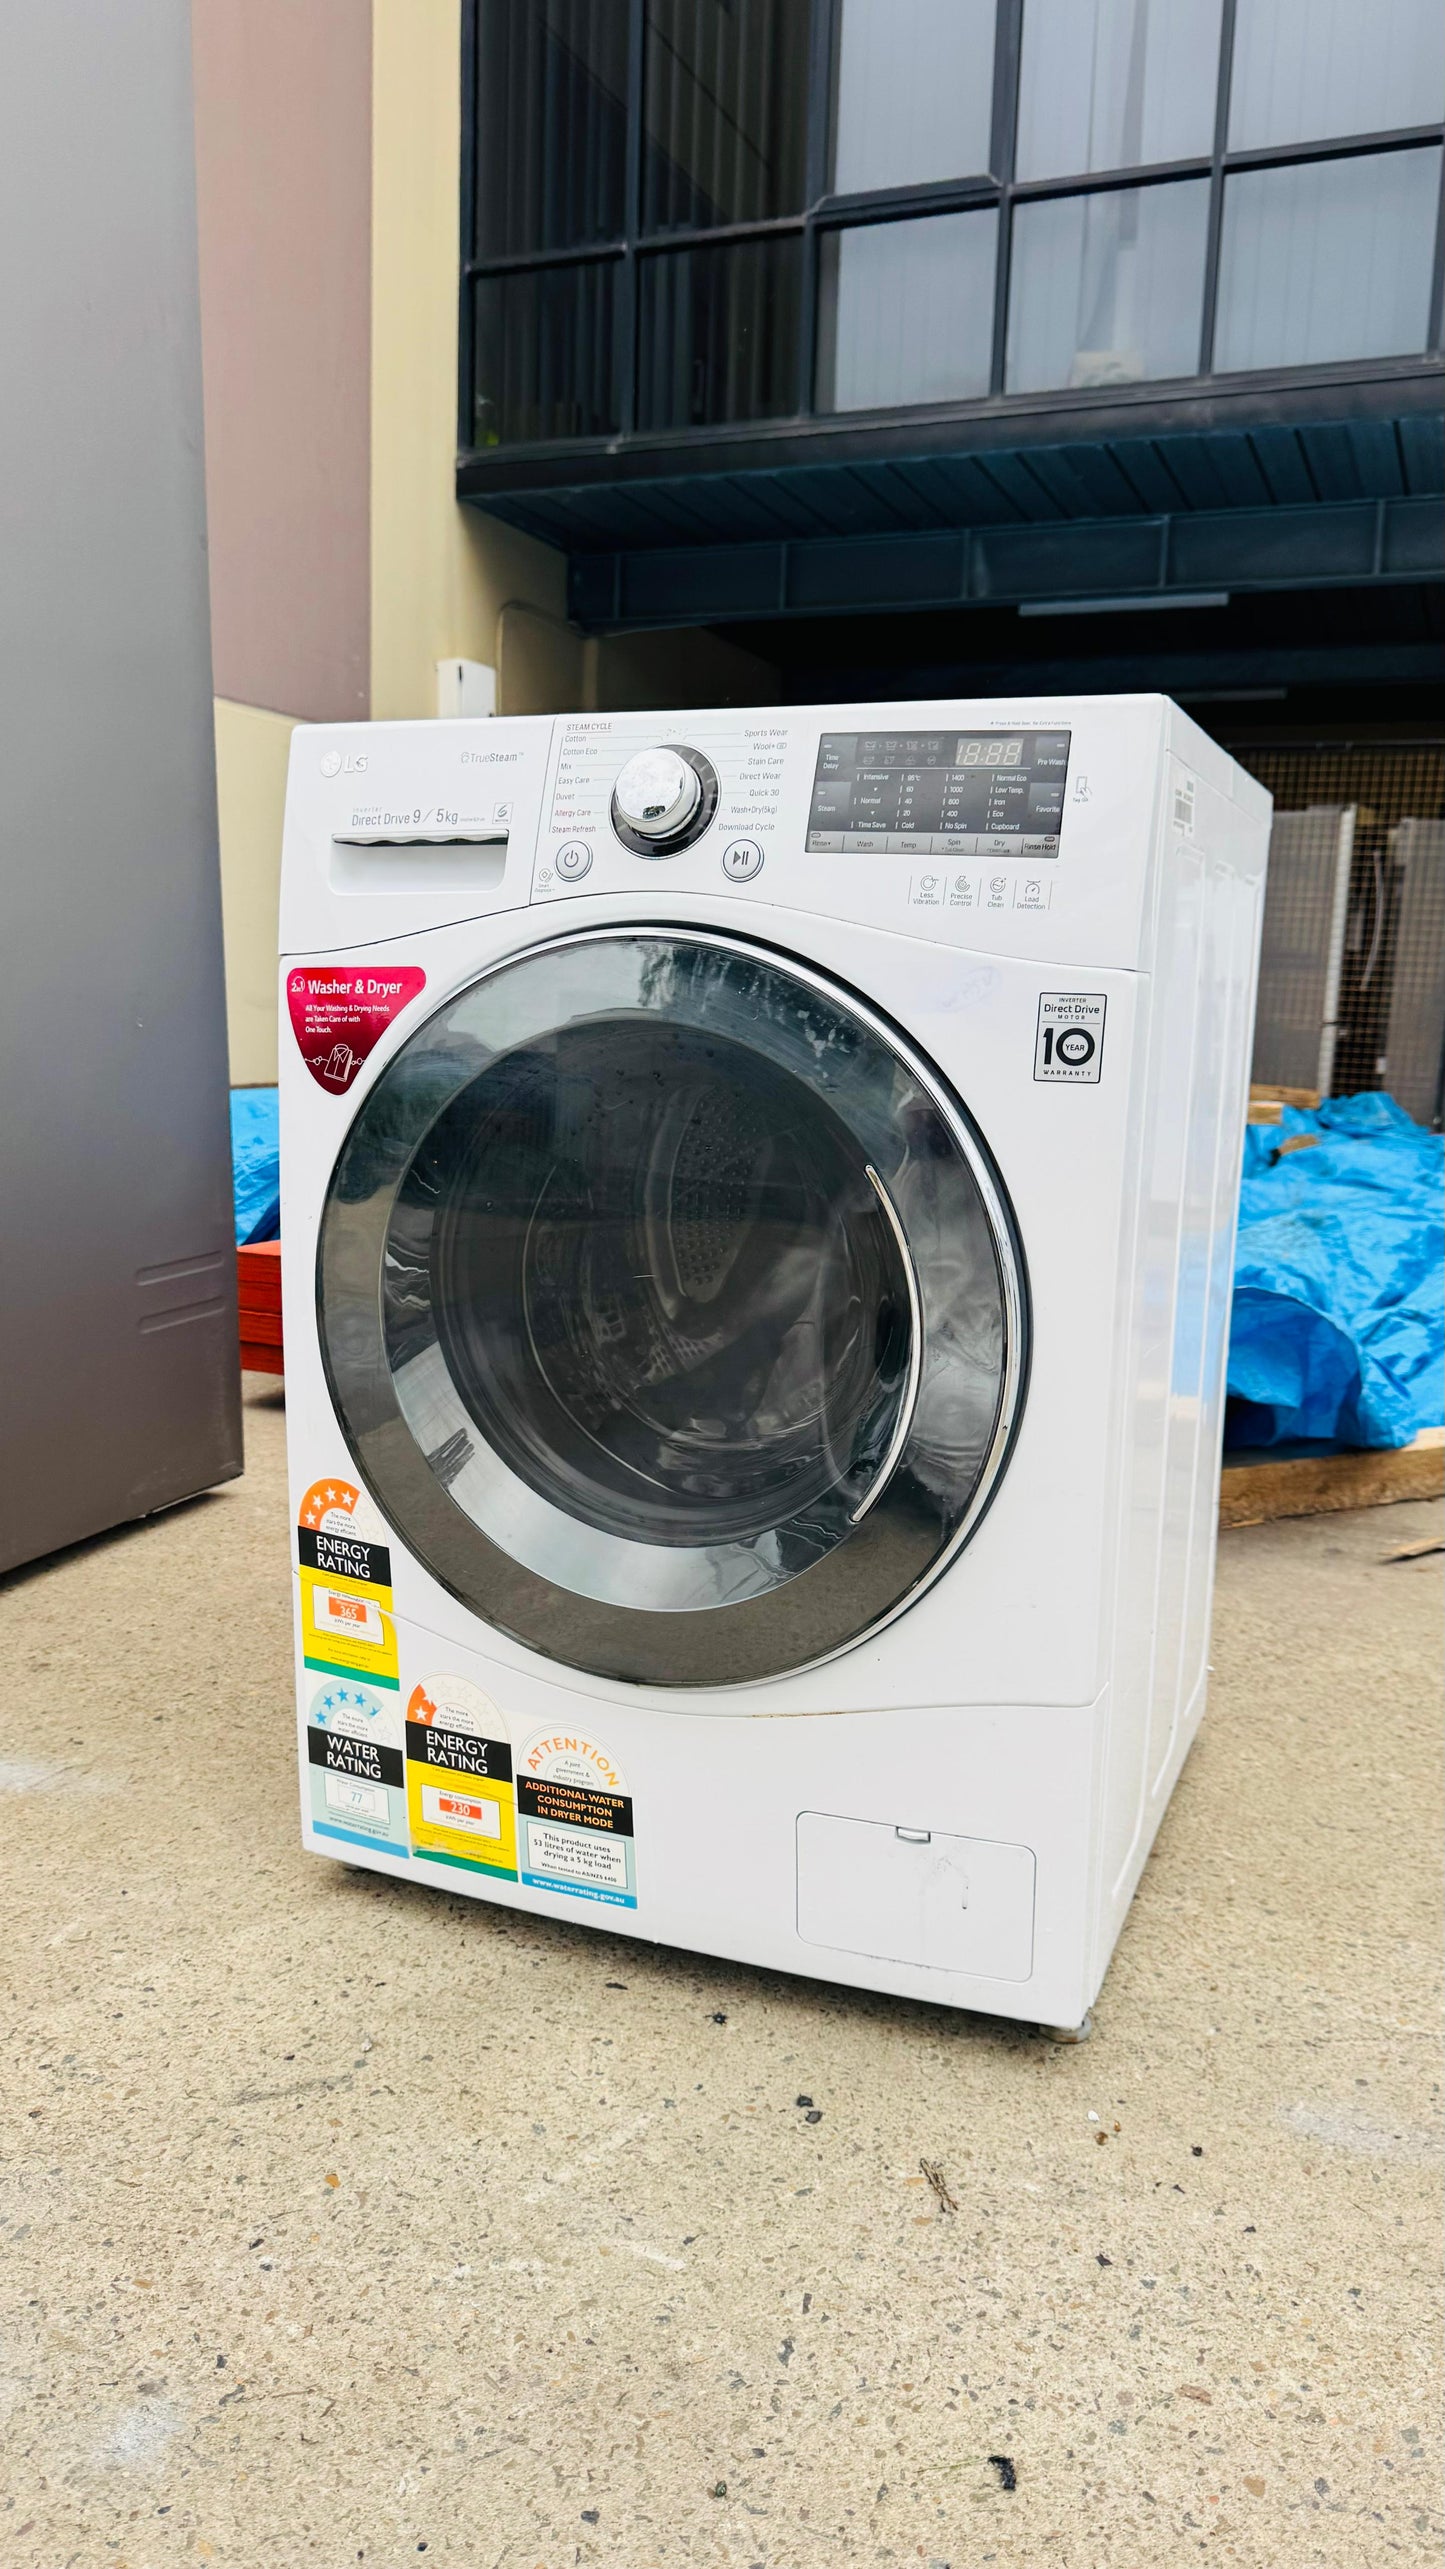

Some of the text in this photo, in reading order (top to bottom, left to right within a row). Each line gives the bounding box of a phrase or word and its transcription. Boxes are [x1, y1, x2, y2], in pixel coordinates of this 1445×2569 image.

[566, 722, 612, 732] STEAM CYCLE
[744, 729, 789, 739] Sports Wear
[565, 735, 587, 743] Cotton
[562, 747, 598, 756] Cotton Eco
[344, 753, 368, 773] LG
[747, 757, 785, 766] Stain Care
[1037, 758, 1066, 766] Pre Wash
[560, 762, 572, 771] Mix
[823, 762, 839, 771] Delay
[558, 776, 590, 786] Easy Care
[739, 772, 782, 781] Direct Wear
[863, 773, 889, 781] Intensive
[951, 774, 965, 782] 1400
[996, 774, 1028, 782] Normal Eco
[749, 788, 780, 797] Quick 30
[995, 786, 1024, 795] Low Temp.
[555, 792, 576, 801] Duvet
[860, 797, 882, 805] Normal
[993, 798, 1006, 806] Iron
[554, 809, 592, 818] Allergy Care
[903, 809, 911, 817] 20
[1035, 805, 1060, 813] Favorite
[352, 814, 381, 826] Direct
[384, 812, 410, 825] Drive
[551, 825, 597, 834] Steam Refresh
[718, 822, 776, 832] Download Cycle
[858, 821, 887, 829] Time Save
[901, 821, 915, 829] Cold
[953, 822, 968, 830] Spin
[990, 823, 1020, 831] Cupboard
[856, 840, 874, 848] Wash
[901, 841, 917, 849] Temp
[947, 838, 961, 846] Spin
[994, 839, 1006, 847] Dry
[1024, 842, 1057, 851] Rinse Hold
[919, 891, 934, 899] Less
[913, 897, 940, 906] Vibration
[307, 978, 352, 994] Washer
[354, 978, 364, 994] &
[367, 978, 403, 999] Dryer
[305, 1004, 390, 1014] All Your Washing & Drying Needs
[1044, 1003, 1100, 1014] Direct Drive
[314, 1015, 329, 1023] Taken
[328, 1015, 341, 1023] Care
[341, 1015, 348, 1023] of
[347, 1015, 361, 1023] with
[305, 1026, 316, 1034] One
[1043, 1027, 1096, 1067] 10
[1065, 1043, 1085, 1052] YEAR
[1043, 1069, 1092, 1077] WARRANTY
[316, 1535, 371, 1562] ENERGY
[317, 1551, 371, 1579] RATING
[340, 1604, 357, 1620] 365
[426, 1730, 489, 1757] ENERGY
[327, 1734, 380, 1763] WATER
[327, 1751, 382, 1779] RATING
[427, 1747, 488, 1775] RATING
[527, 1737, 620, 1787] ATTENTION
[525, 1781, 625, 1809] ADDITIONAL WATER
[450, 1801, 471, 1816] 230
[537, 1795, 613, 1818] CONSUMPTION
[537, 1806, 614, 1829] IN DRYER MODE
[543, 1832, 611, 1854] This product uses
[533, 1838, 622, 1864] 53 litres of water when
[543, 1850, 569, 1863] drying
[583, 1858, 593, 1868] kg
[594, 1860, 612, 1870] load
[541, 1861, 558, 1869] When
[558, 1865, 575, 1874] tested
[532, 1878, 625, 1904] www.waterrating.gov.au
